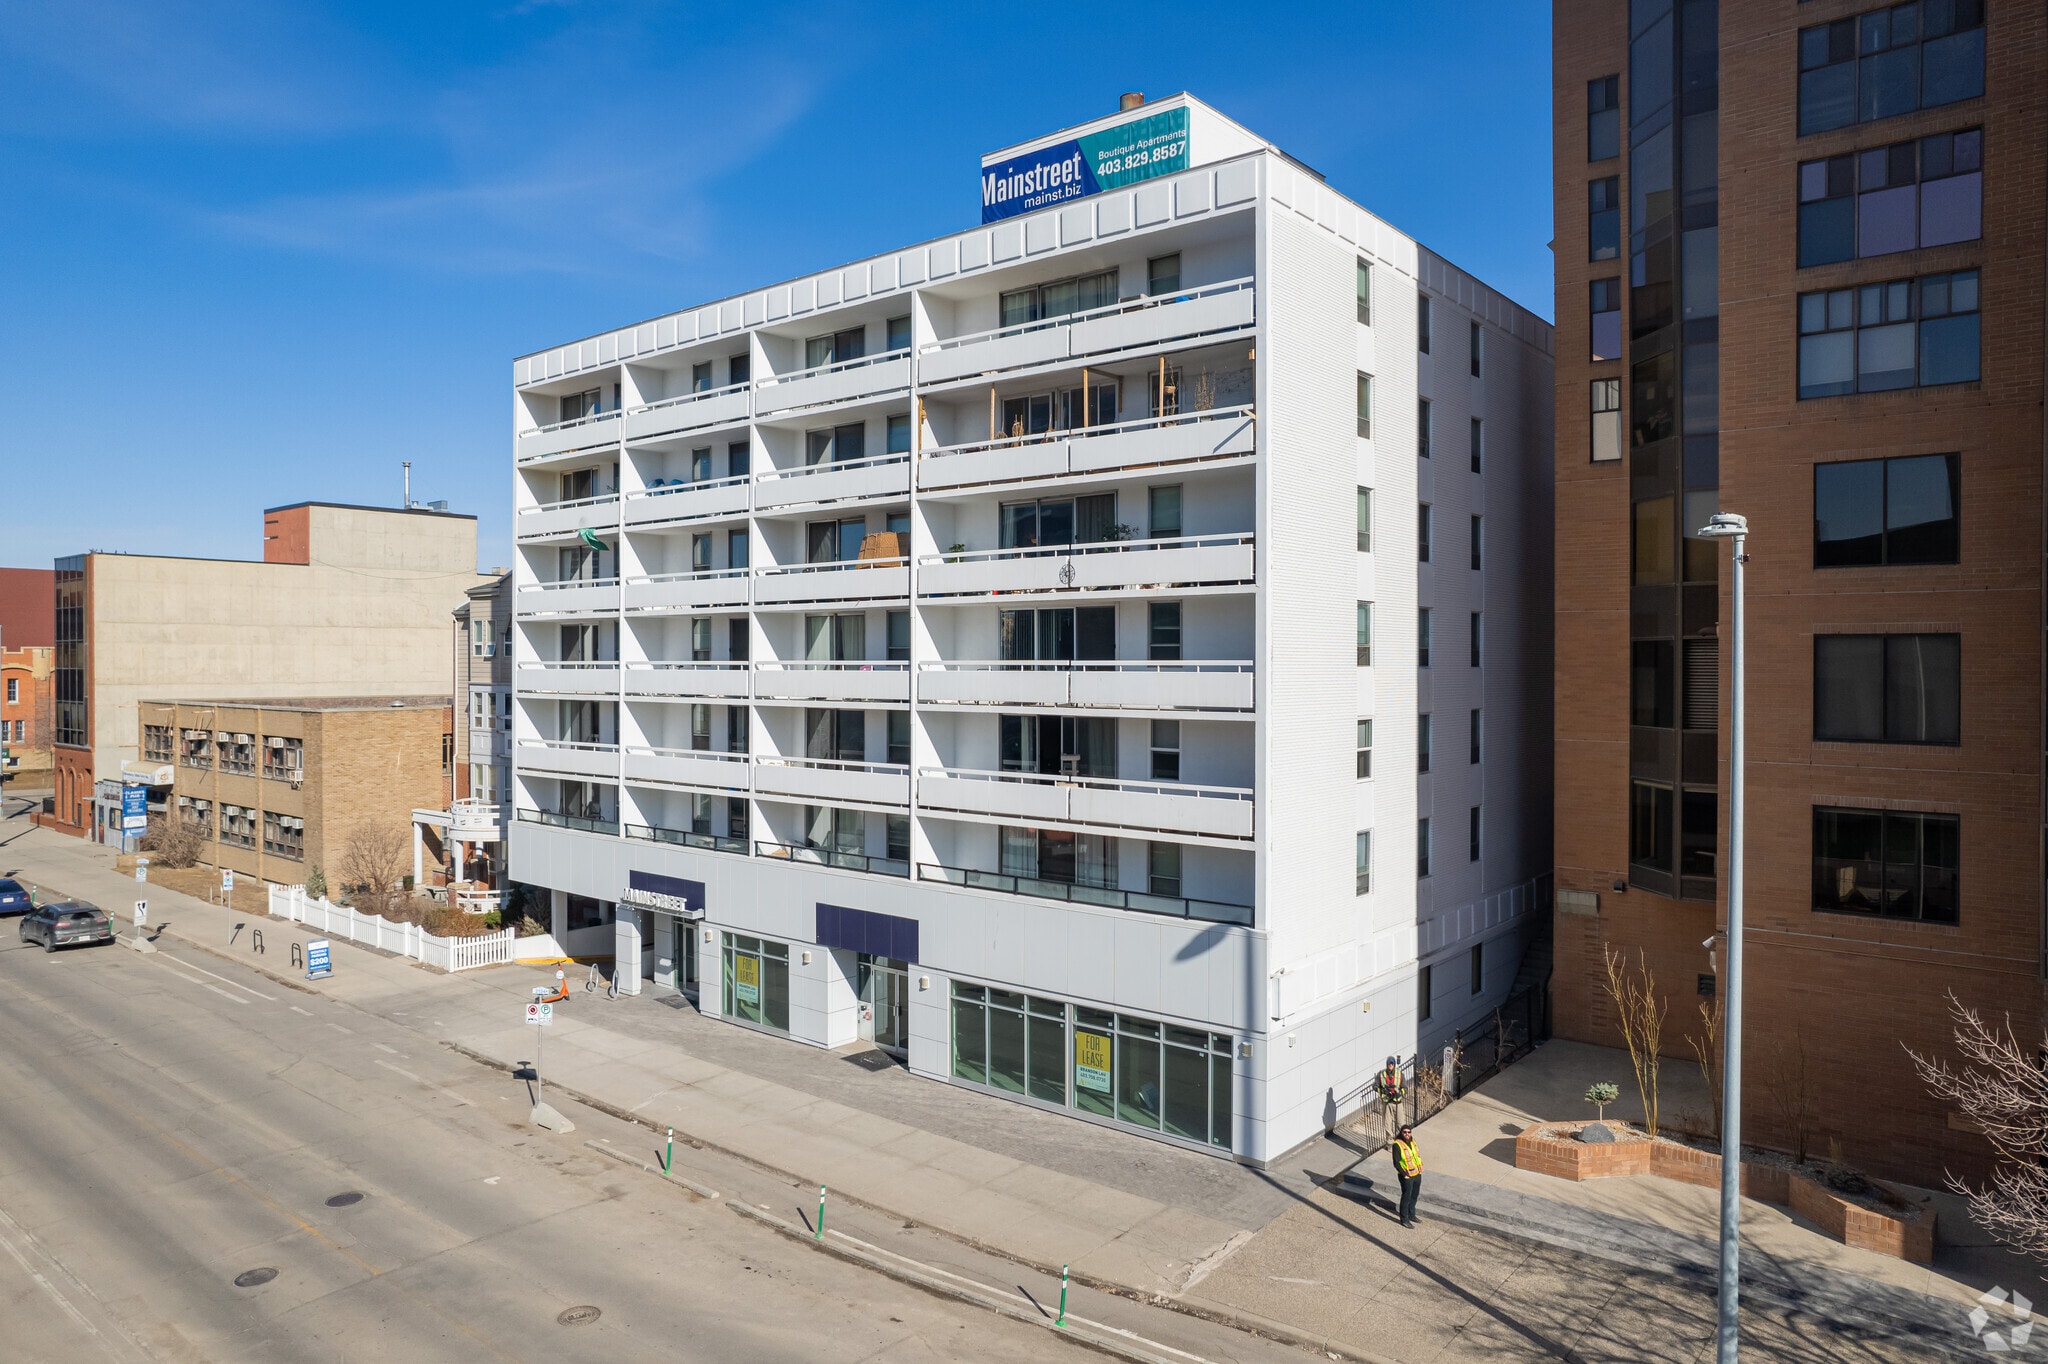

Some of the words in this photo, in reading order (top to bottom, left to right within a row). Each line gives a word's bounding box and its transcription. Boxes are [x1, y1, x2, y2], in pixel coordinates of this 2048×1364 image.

[1098, 142, 1135, 161] Boutique
[1136, 129, 1186, 150] Apartments
[1097, 141, 1186, 177] 403.829.8587
[982, 151, 1082, 207] Mainstreet
[1024, 184, 1082, 209] mainst.biz
[624, 887, 687, 912] MAINSTREET
[310, 956, 329, 966] $200
[742, 957, 753, 971] FOR
[1085, 1034, 1101, 1052] FOR
[1082, 1050, 1104, 1069] LEASE
